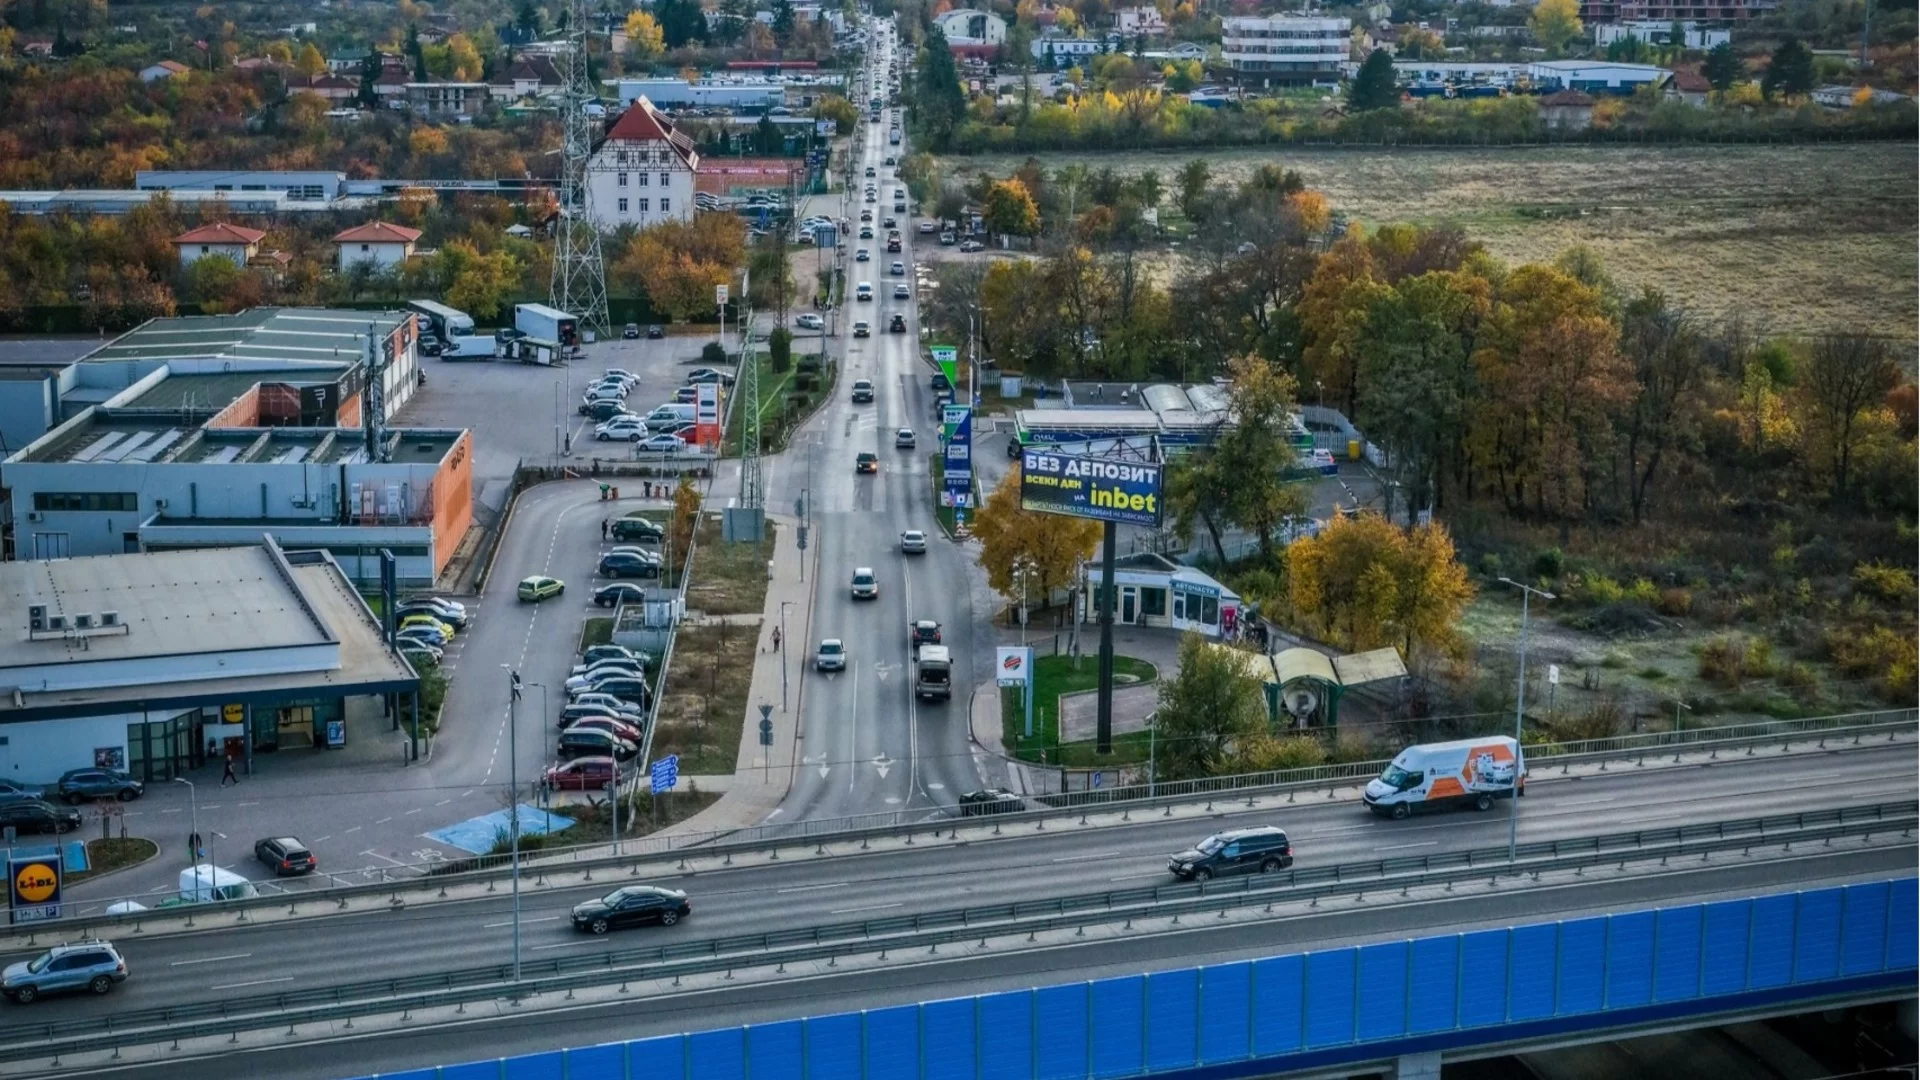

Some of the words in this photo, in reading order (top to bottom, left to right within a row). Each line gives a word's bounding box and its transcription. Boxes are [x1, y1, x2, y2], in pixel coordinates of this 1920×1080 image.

[1025, 455, 1060, 473] БЕЗ
[1064, 459, 1158, 484] ДЕПОЗИТ
[1025, 474, 1058, 486] ВСЕКИ
[1060, 478, 1082, 489] ДЕН
[1090, 482, 1156, 513] inbet
[1175, 582, 1215, 595] АВТОЧАСТИ
